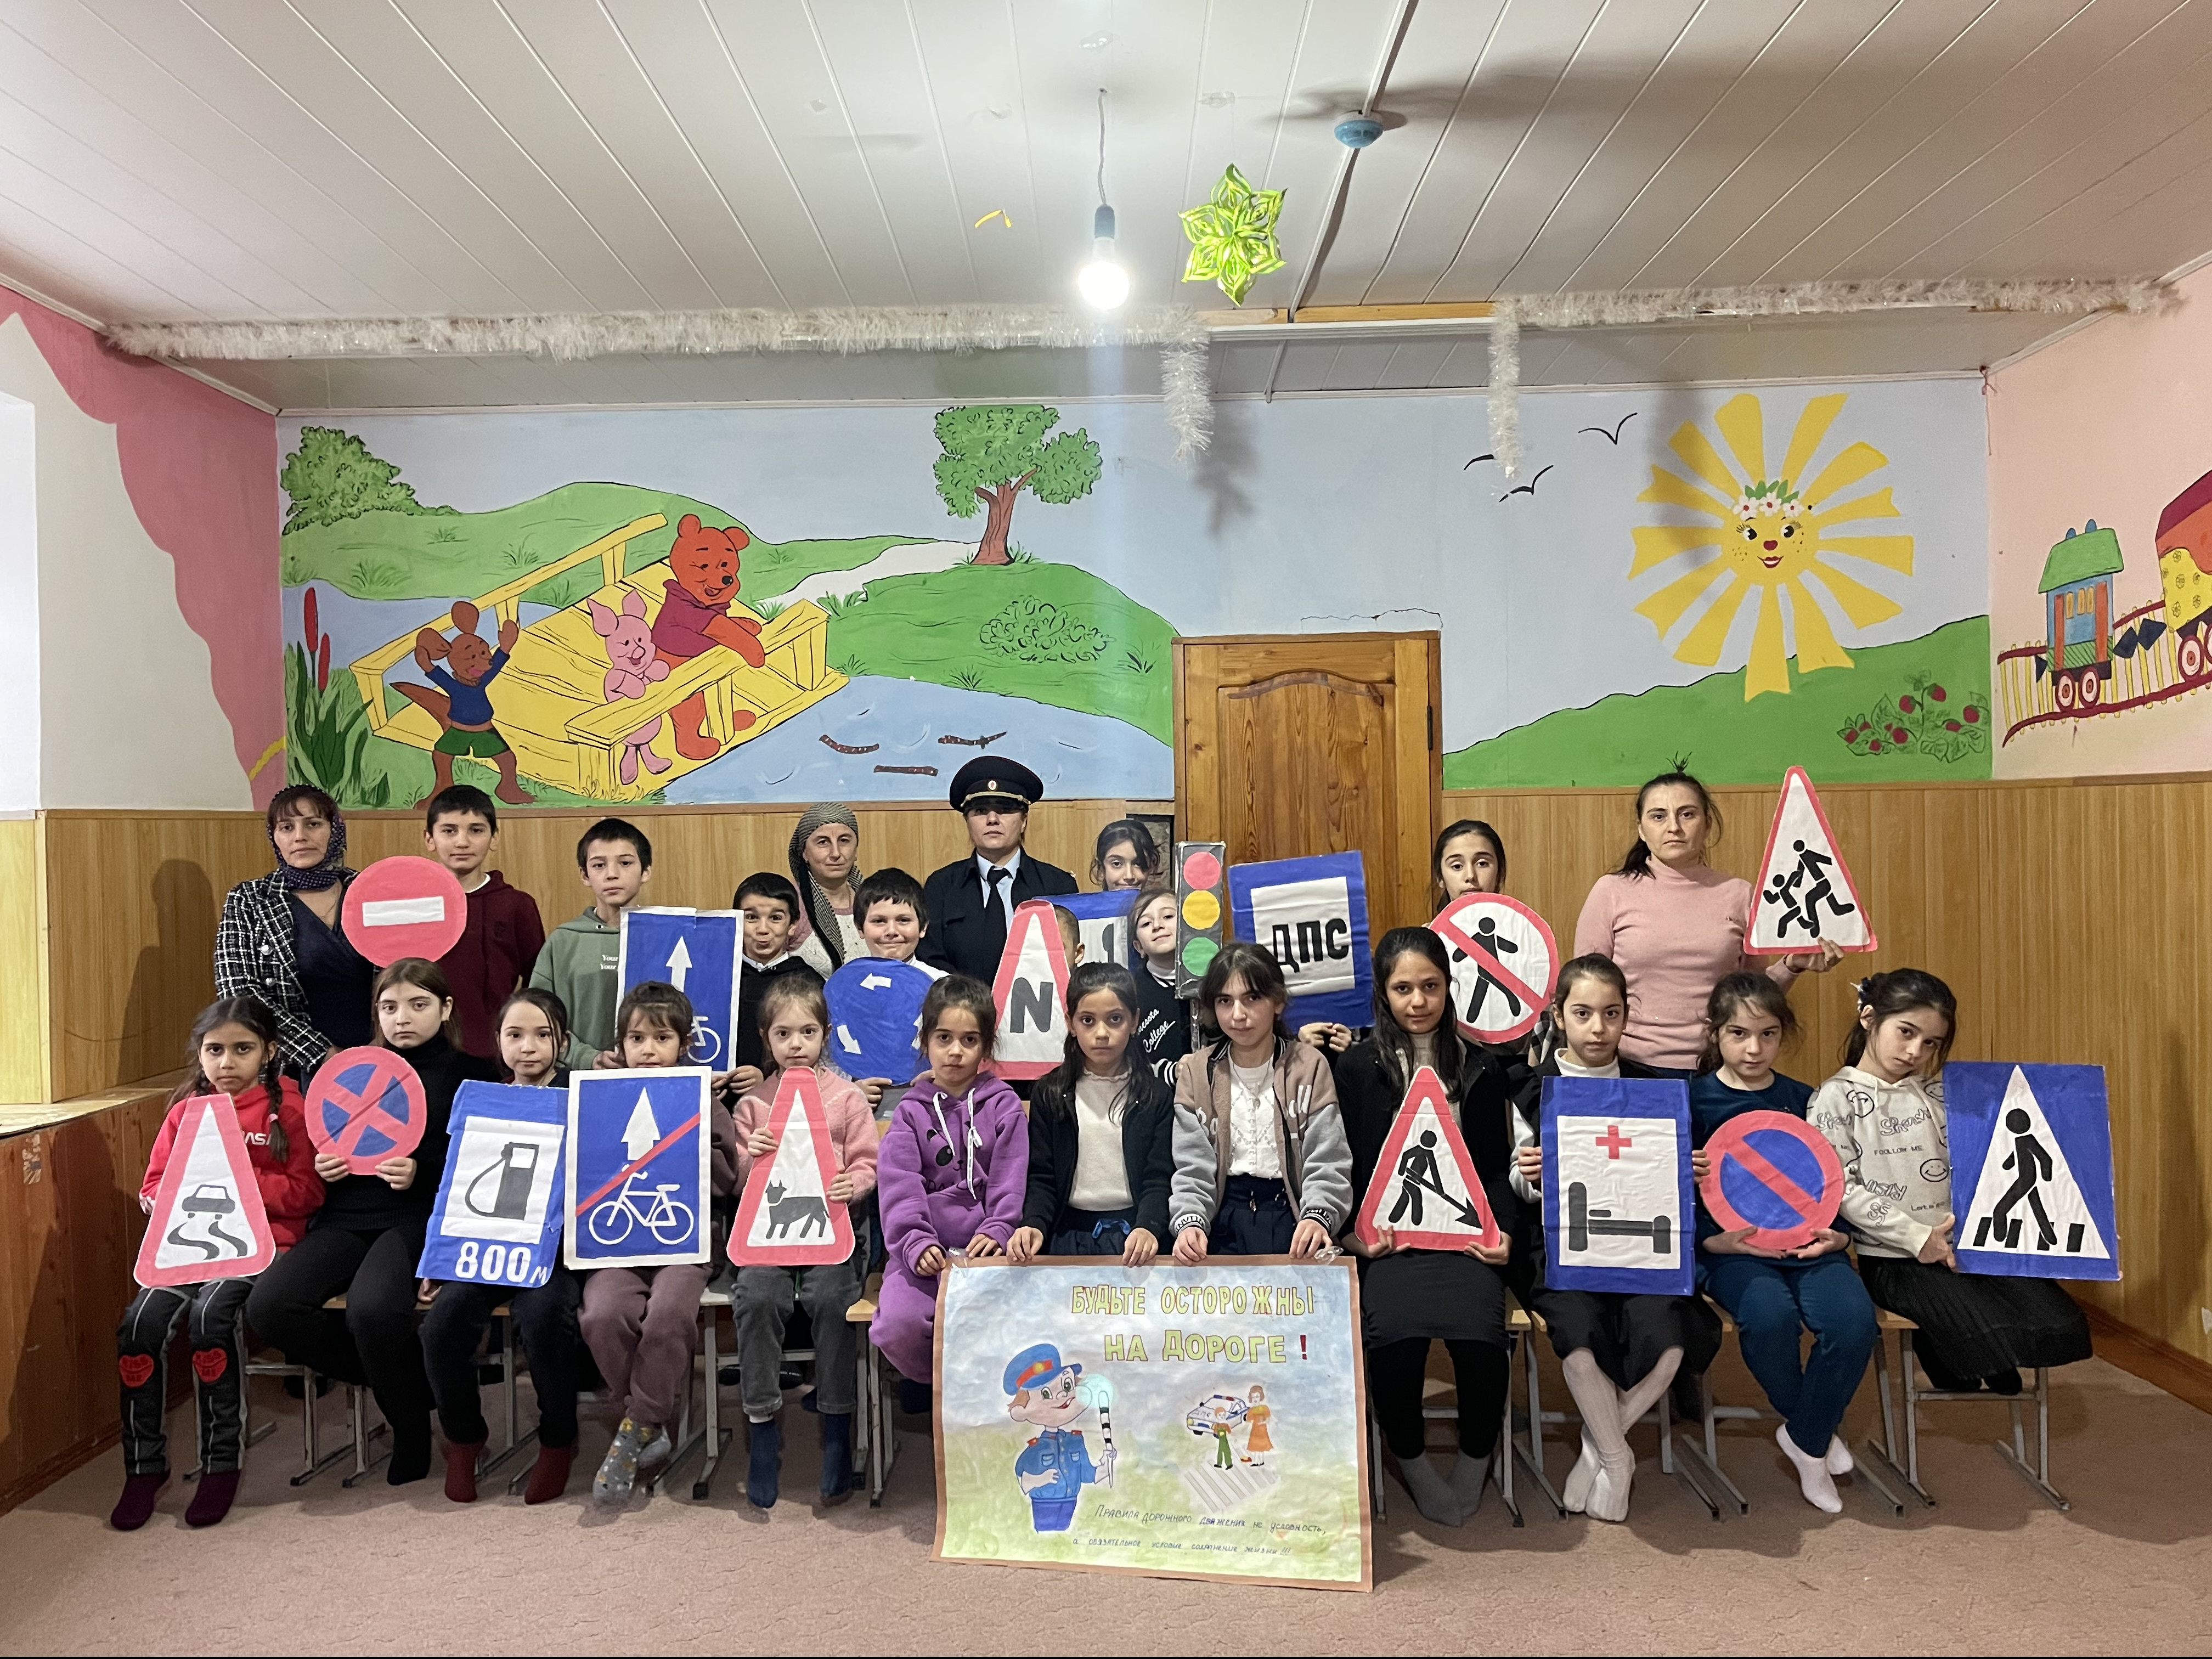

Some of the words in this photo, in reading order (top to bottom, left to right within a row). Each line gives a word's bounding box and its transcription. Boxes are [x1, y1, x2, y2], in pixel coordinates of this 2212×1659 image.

[1272, 918, 1349, 973] ДПС
[1143, 1020, 1170, 1053] College
[455, 1242, 531, 1283] 800
[1071, 1284, 1146, 1315] БУДЬТЕ
[1160, 1285, 1314, 1316] ОСТОРОЖНЫ
[1104, 1334, 1148, 1362] НА
[1162, 1329, 1287, 1363] ДОРОГЕ
